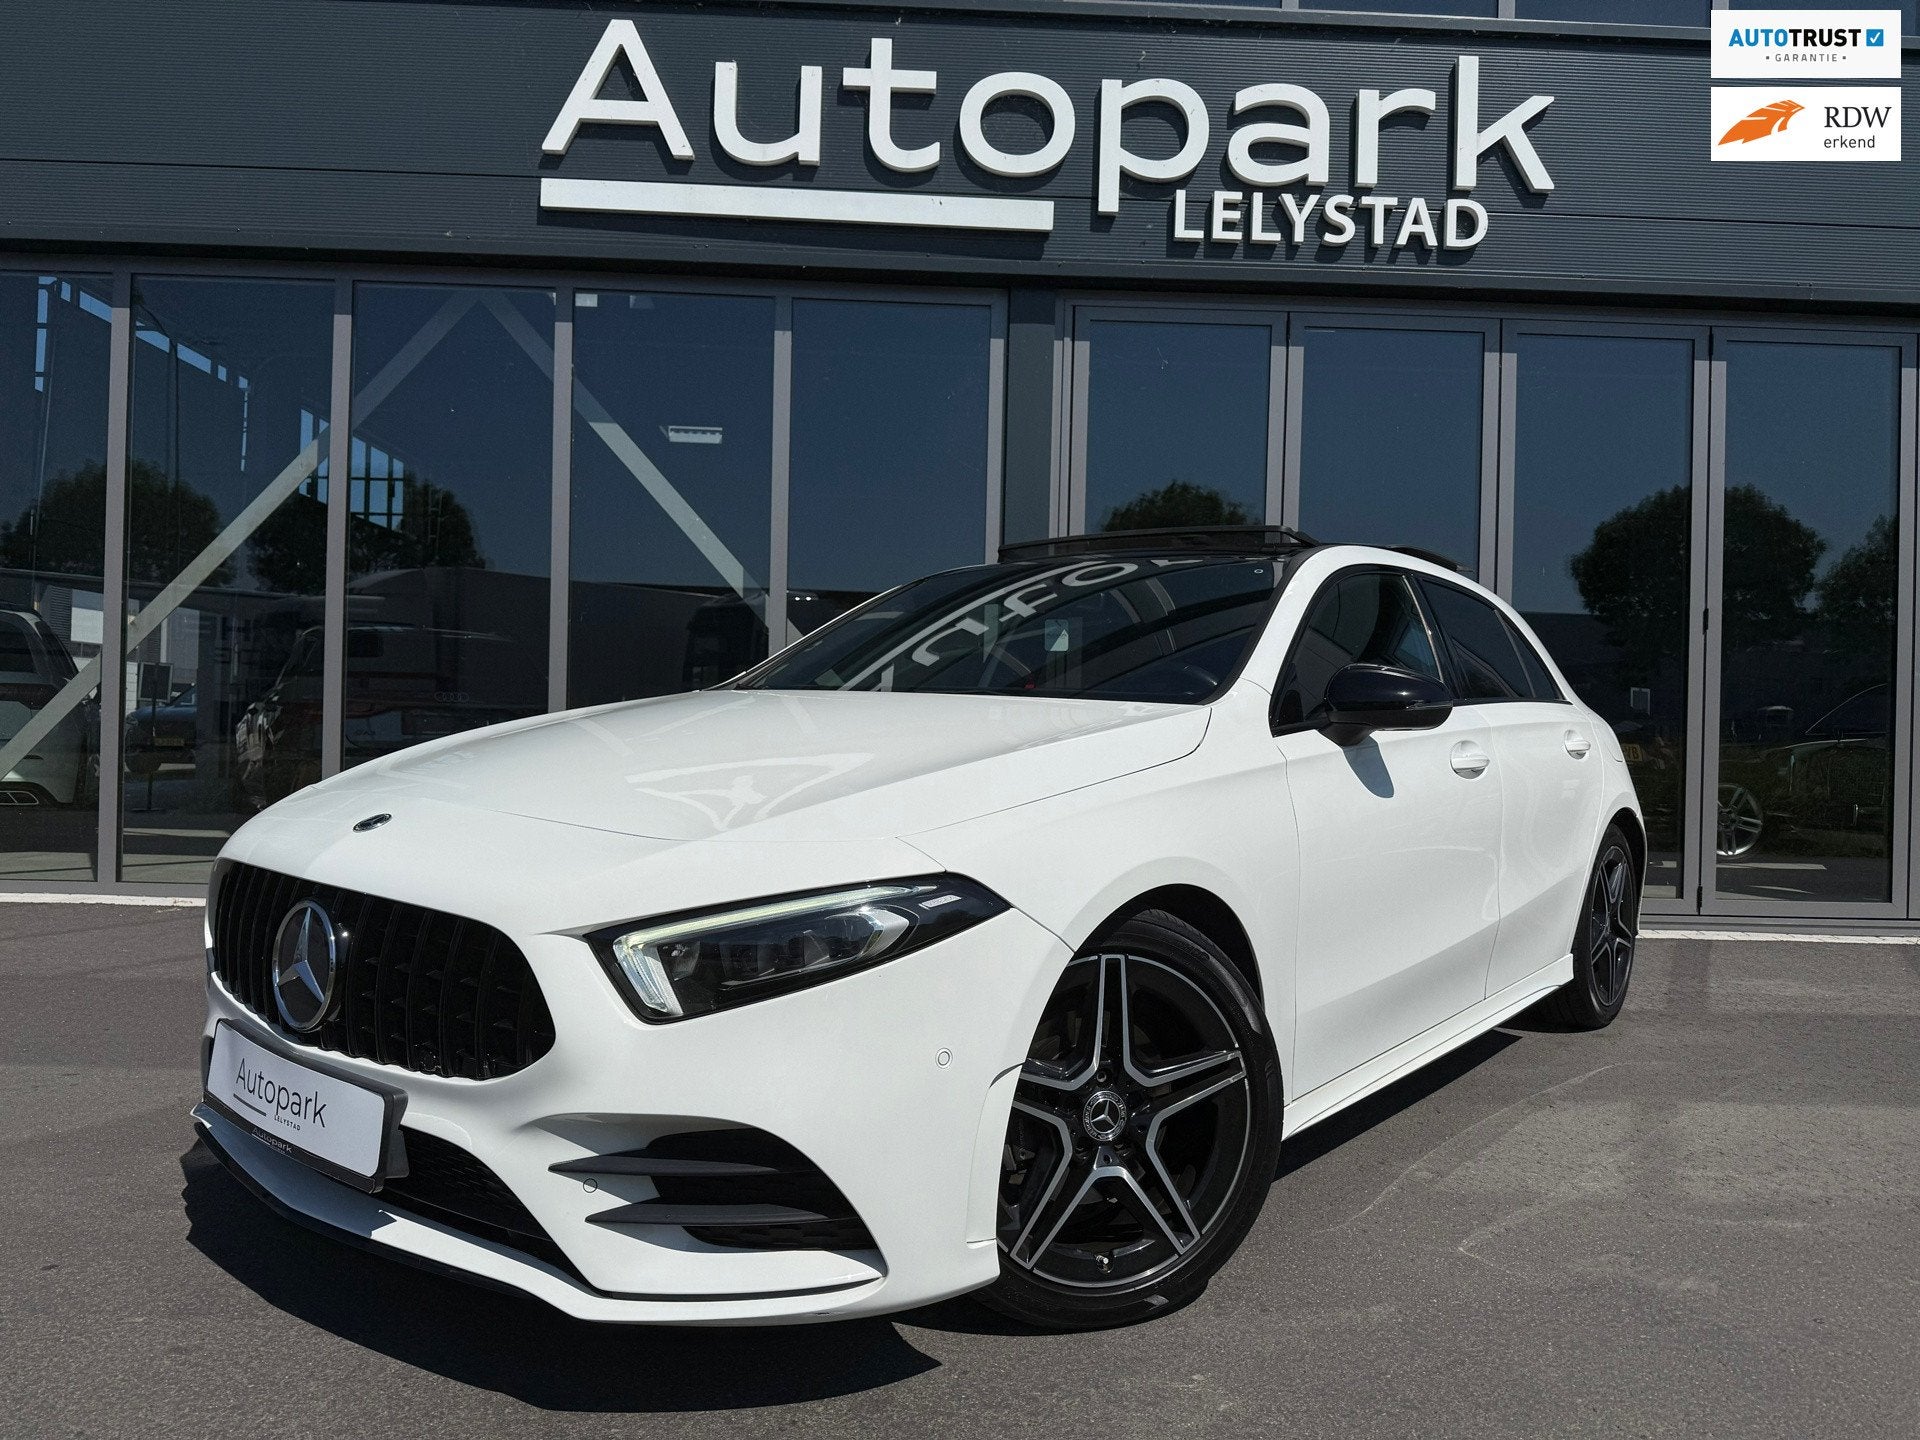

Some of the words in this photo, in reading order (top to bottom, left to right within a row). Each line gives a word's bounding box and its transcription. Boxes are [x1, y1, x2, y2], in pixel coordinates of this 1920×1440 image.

[541, 18, 1555, 217] Autopark
[1173, 188, 1489, 251] LELYSTAD
[236, 1057, 327, 1128] Autopark
[274, 1114, 301, 1131] LELYSTAD
[251, 1127, 293, 1153] Autopark
